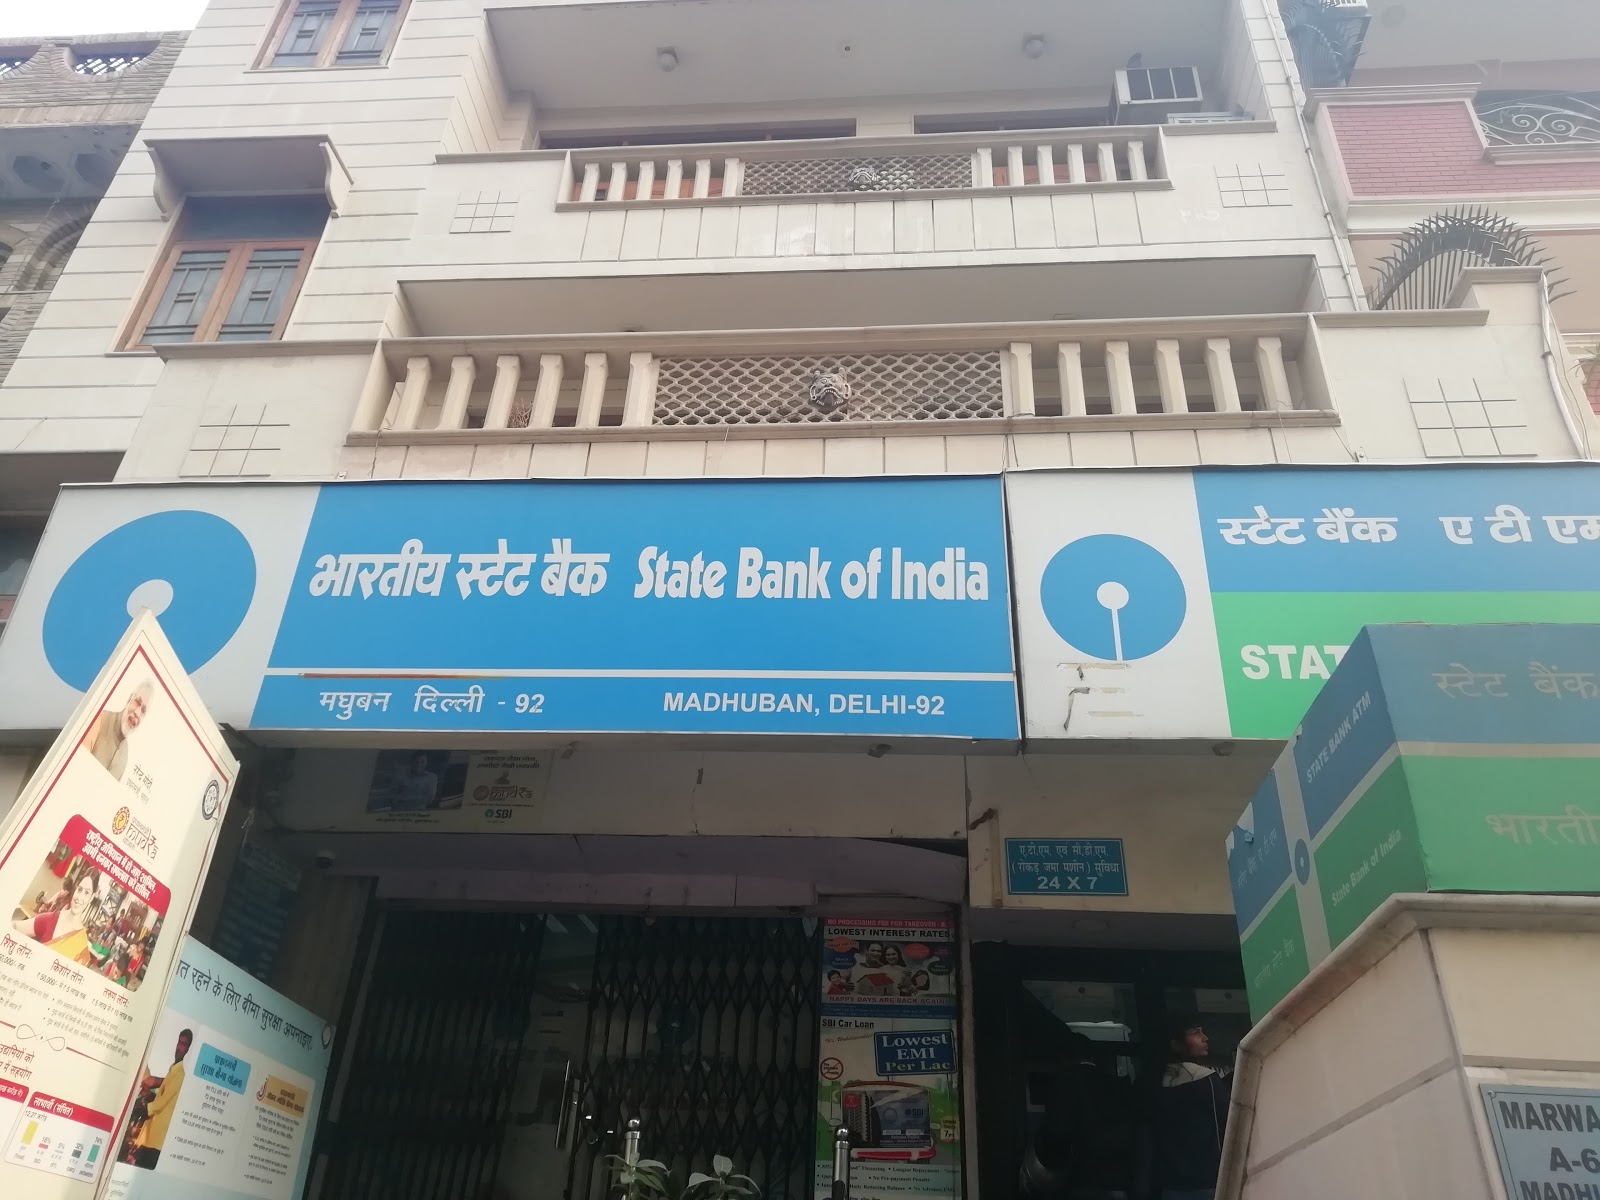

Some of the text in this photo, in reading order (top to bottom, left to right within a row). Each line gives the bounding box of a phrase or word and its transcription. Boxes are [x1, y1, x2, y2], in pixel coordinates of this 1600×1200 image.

[1217, 505, 1306, 544] स्टेट
[1313, 507, 1398, 543] बैंक
[1438, 516, 1473, 544] ए
[1484, 504, 1532, 543] टी
[309, 538, 452, 600] भारतीय
[455, 538, 537, 600] स्टेट
[634, 546, 989, 600] State Bank of India
[1431, 662, 1509, 699] स्टेट
[413, 685, 486, 713] दिल्ली
[515, 694, 545, 713] 92
[663, 693, 945, 716] MADHUBAN, DELHI-92
[1307, 690, 1371, 783] STATE BANK ATM
[495, 809, 512, 819] SBI
[1094, 859, 1119, 877] सुविधा
[1331, 828, 1402, 907] State Bank of India
[1037, 876, 1060, 889] 24
[1087, 876, 1097, 889] 7
[828, 928, 866, 936] LOWEST
[869, 928, 916, 937] INTEREST
[192, 969, 211, 991] रहने
[212, 974, 223, 996] के
[223, 982, 241, 1012] लिए
[242, 993, 261, 1019] बीमा
[260, 1008, 283, 1030] सुरक्षा
[822, 1019, 874, 1029] SBI Car Loan
[881, 1033, 949, 1047] Lowest
[896, 1047, 936, 1060] EMI
[885, 1061, 951, 1071] Per Lac
[1520, 1181, 1600, 1200] MADH
